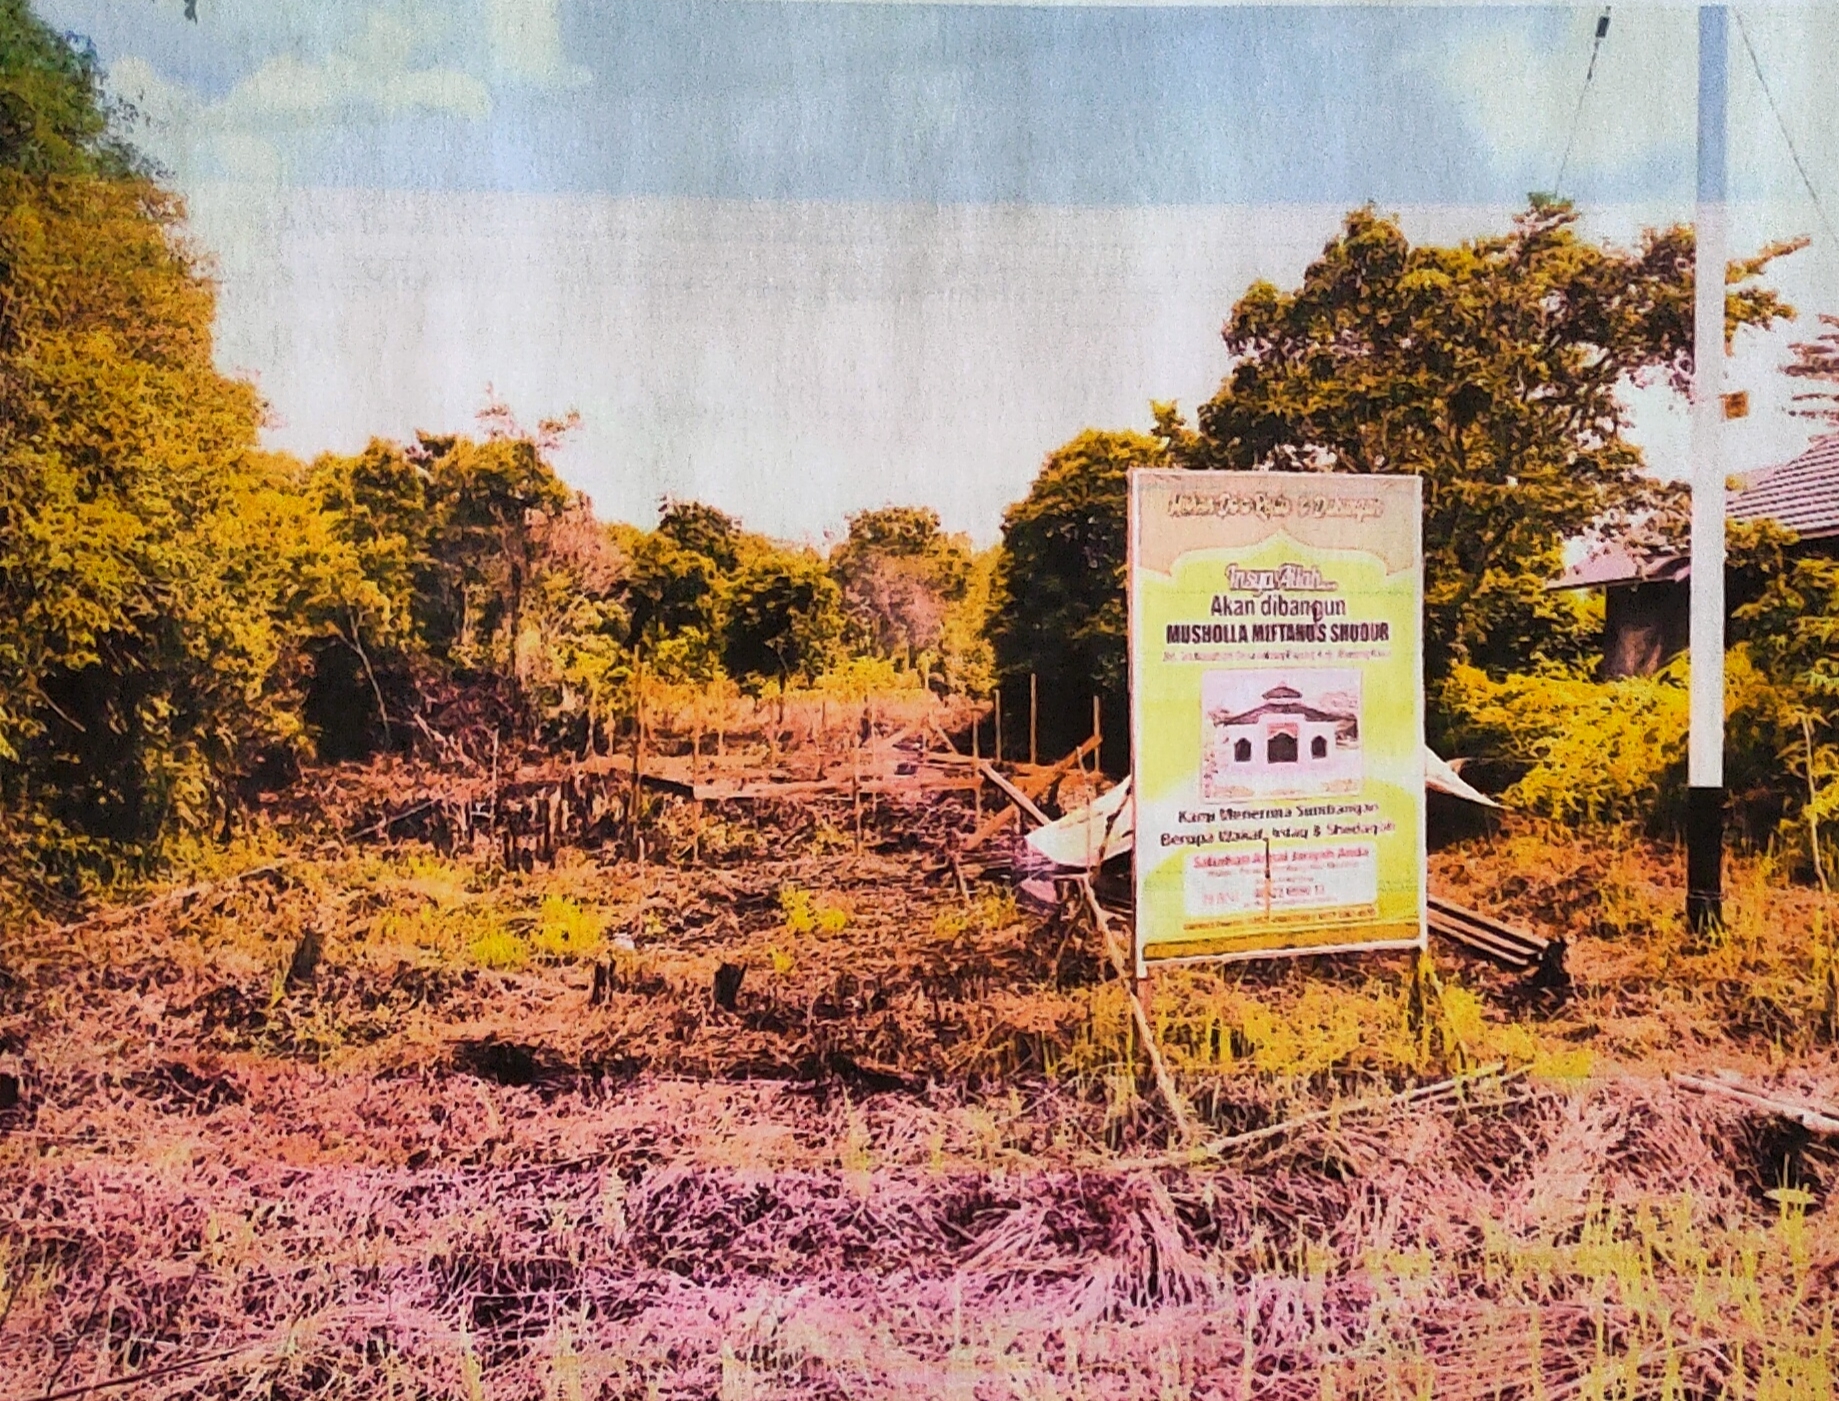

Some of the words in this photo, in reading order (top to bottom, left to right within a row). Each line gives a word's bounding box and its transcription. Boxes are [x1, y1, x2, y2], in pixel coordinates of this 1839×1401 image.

[1211, 595, 1255, 617] Akan
[1260, 594, 1346, 622] dibangun
[1166, 623, 1248, 645] MUSHOLLA
[1330, 622, 1390, 643] SHUDUR
[1178, 810, 1216, 824] Kami
